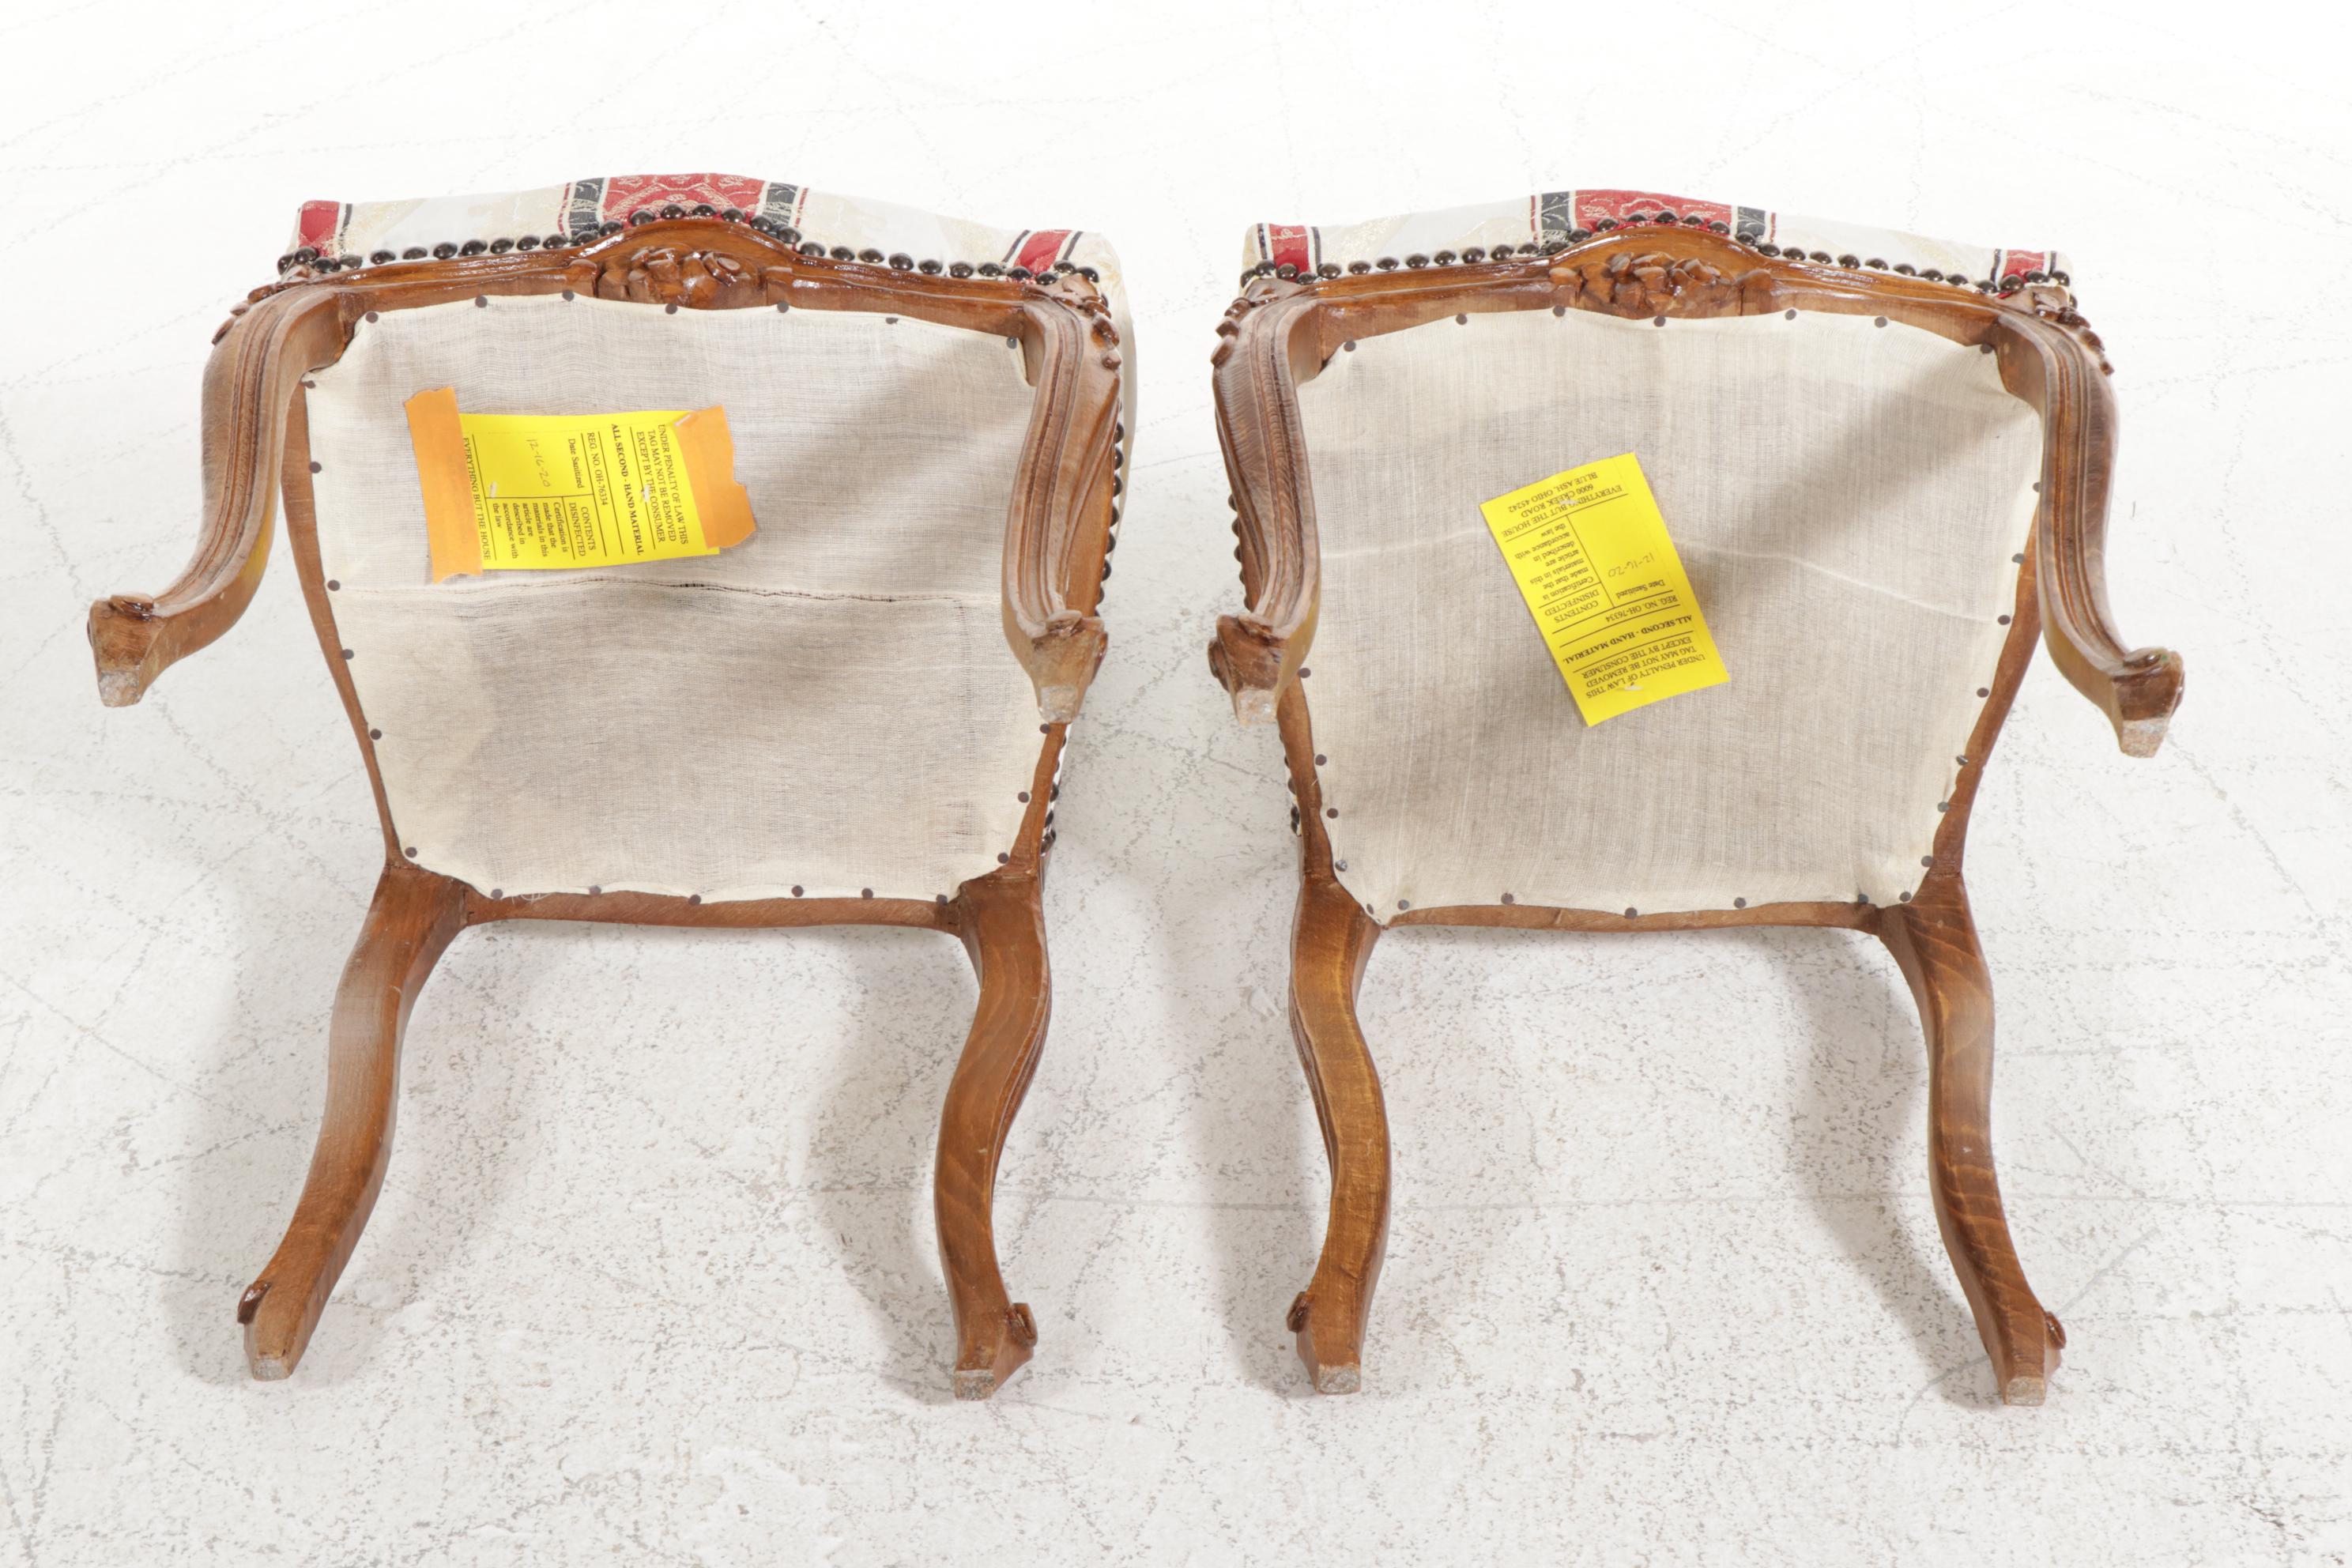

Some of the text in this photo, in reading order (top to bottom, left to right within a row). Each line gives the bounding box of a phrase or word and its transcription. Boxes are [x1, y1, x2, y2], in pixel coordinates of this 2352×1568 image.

[612, 423, 621, 441] ALL
[568, 438, 585, 488] Date Sanitized
[587, 432, 609, 506] REG. NO. OH-76334
[616, 442, 628, 477] SECOND
[636, 431, 665, 543] EXCEPT BY THE CONSUMER
[648, 429, 677, 541] TAG MAY NOT BE REMOVED
[658, 424, 688, 545] UNDER PENALTY OF LAW THIS
[1574, 472, 1597, 485] BLUE
[462, 436, 491, 560] EVERYTHING BUT THE HOUSE
[624, 484, 635, 508] HAND
[1508, 498, 1530, 513] 45242
[1521, 483, 1594, 518] 6000 CREEK ROAD
[1531, 488, 1554, 503] OHIO
[512, 503, 525, 536] described
[522, 503, 533, 525] article
[543, 502, 552, 522] made
[1532, 511, 1549, 524] THE
[1549, 503, 1567, 516] BUT
[503, 502, 519, 559] accordance with
[533, 502, 545, 534] materials
[541, 544, 549, 557] this
[547, 522, 556, 536] that
[553, 501, 568, 545] Certification
[568, 502, 586, 557] DISINFECTED
[581, 506, 597, 551] CONTENTS
[629, 510, 644, 555] MATERIAL
[1501, 520, 1531, 538] HOUSE
[1540, 523, 1566, 538] the law
[1514, 531, 1571, 560] accordance with
[1541, 540, 1575, 560] described
[1545, 548, 1580, 567] article are
[1543, 567, 1589, 590] made that the
[1552, 557, 1585, 576] materials
[1529, 575, 1544, 586] this
[1549, 575, 1594, 598] Certification
[1615, 579, 1665, 600] Date Sanitized
[1544, 589, 1599, 617] DISINFECTED
[1554, 600, 1599, 624] CONTENTS
[1605, 594, 1677, 623] REG. NO. OH-76334
[1641, 619, 1675, 635] SECOND
[1675, 614, 1693, 624] ALL
[1609, 631, 1635, 646] HAND
[1562, 641, 1609, 665] MATERIAL
[1581, 635, 1692, 679] EXCEPT BY THE CONSUMER
[1585, 645, 1696, 688] TAG MAY NOT BE REMOVED
[1585, 653, 1706, 699] UNDER PENALTY OF LAW THIS
